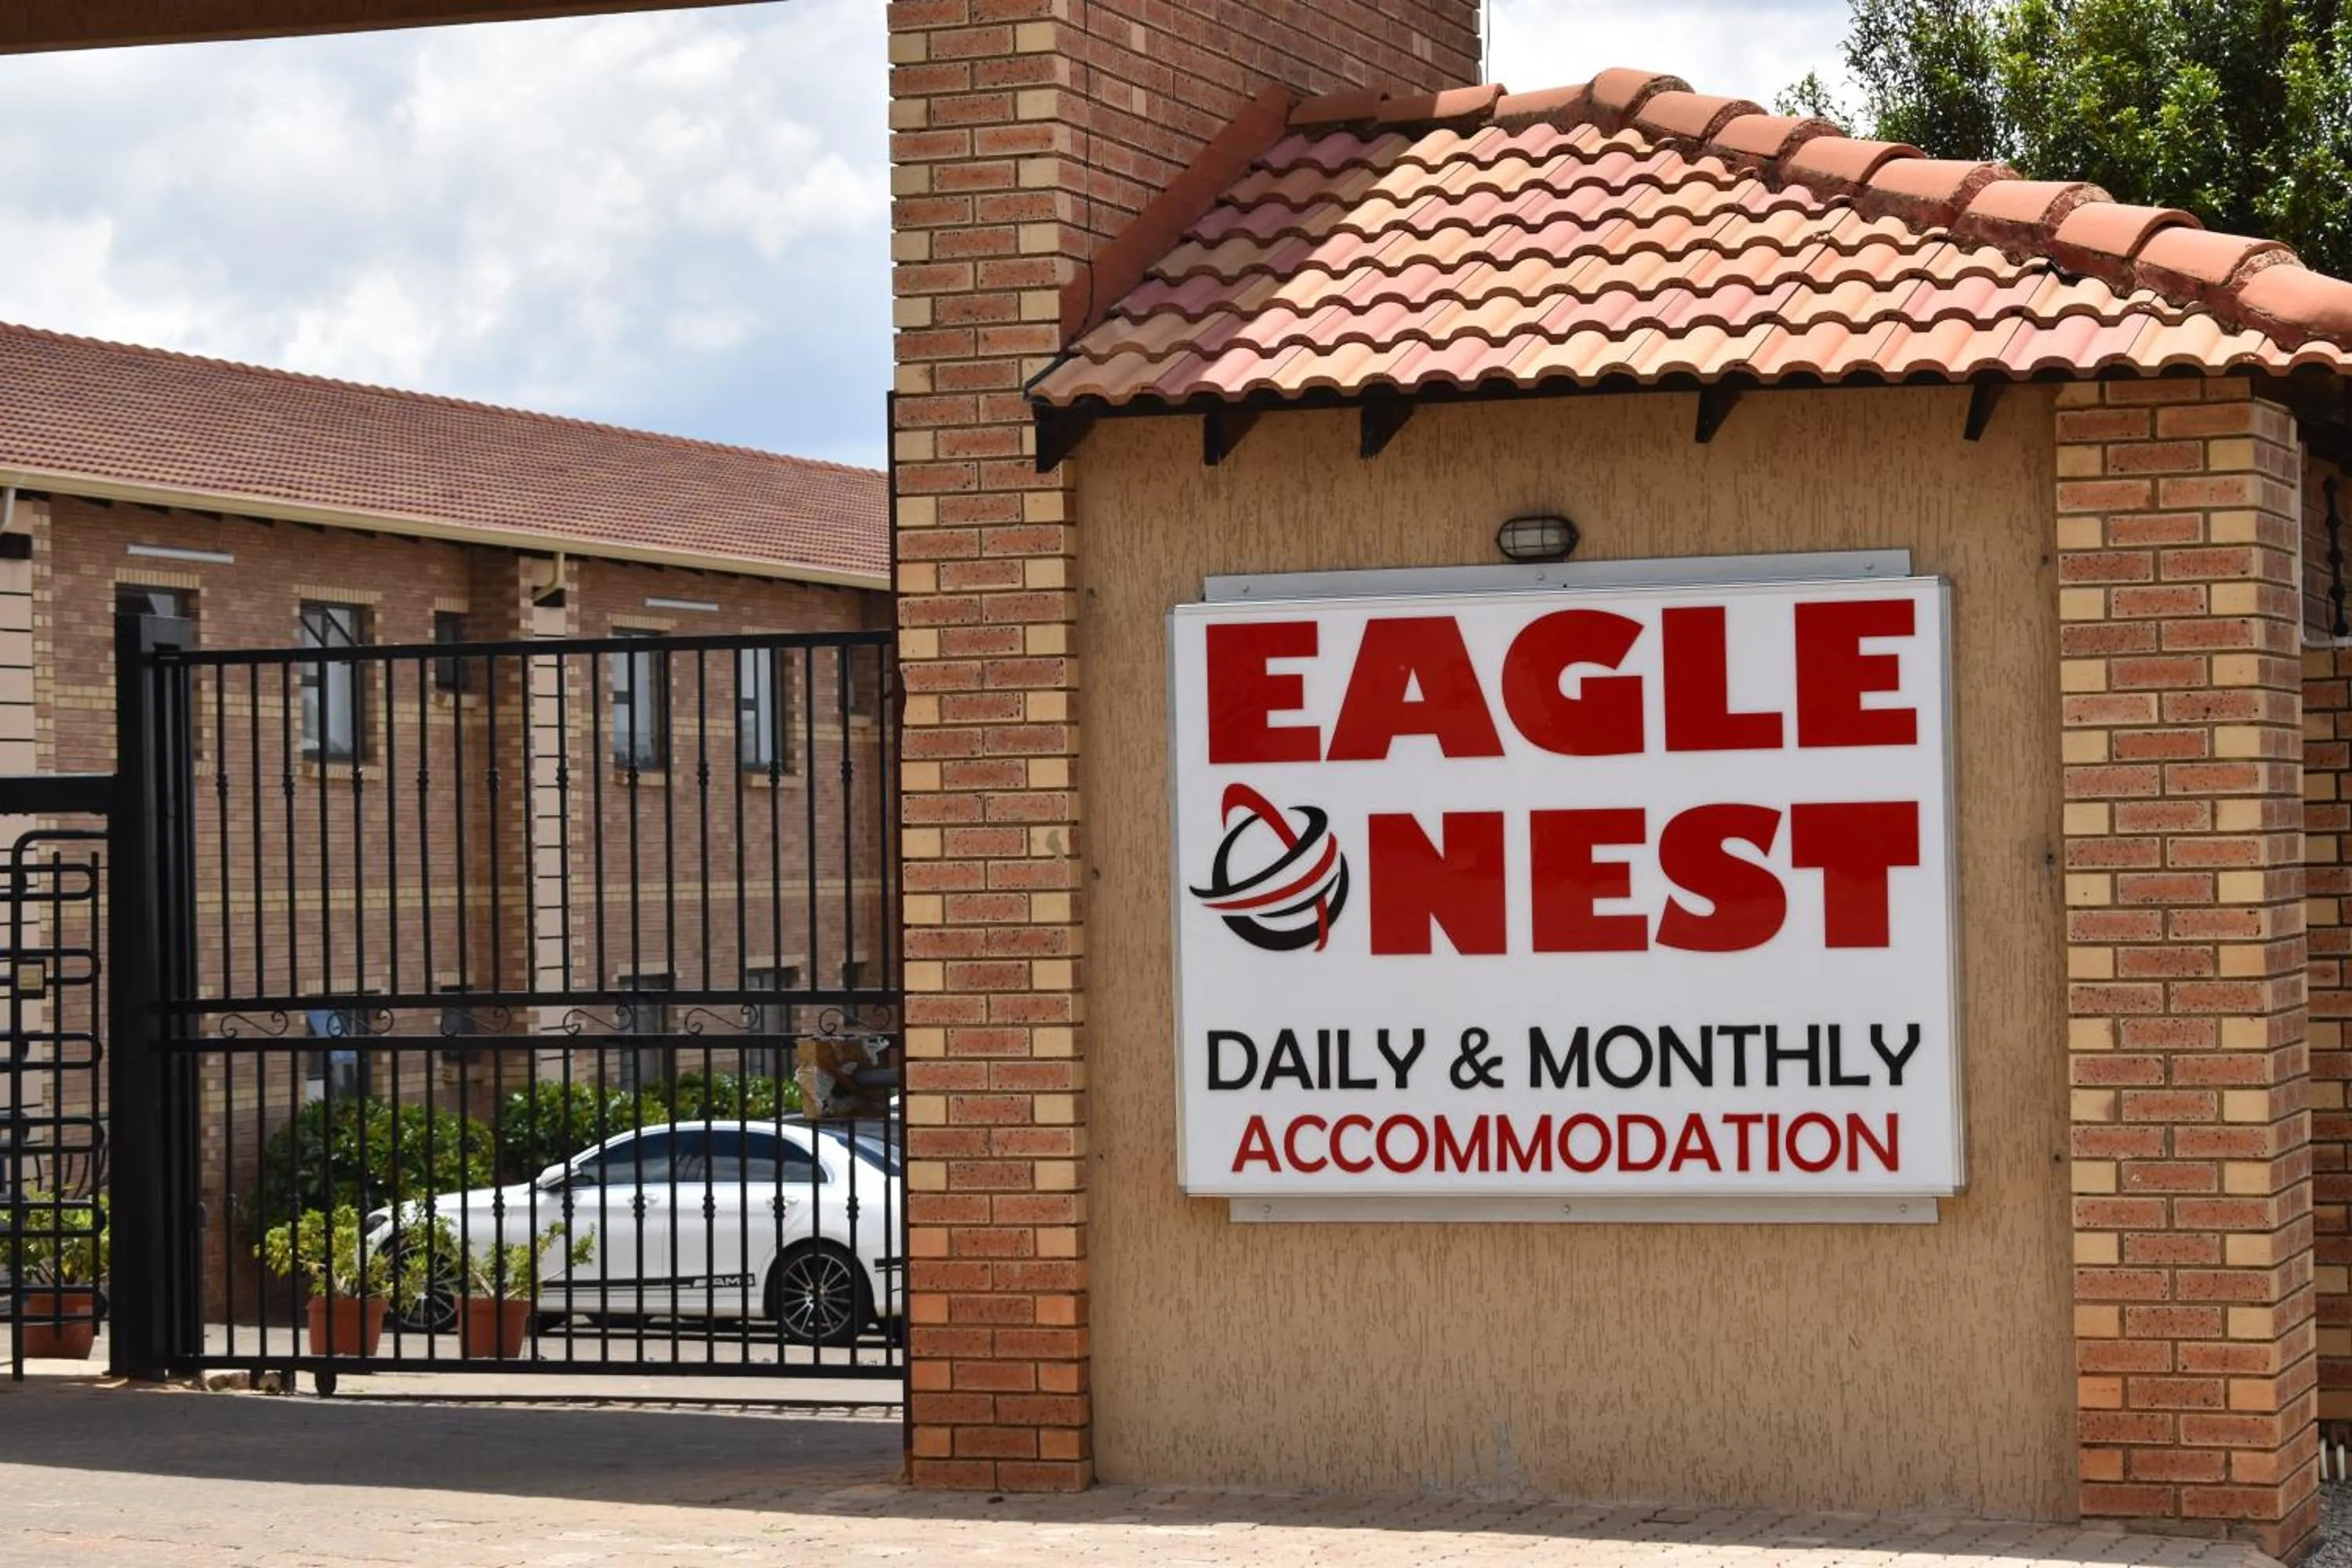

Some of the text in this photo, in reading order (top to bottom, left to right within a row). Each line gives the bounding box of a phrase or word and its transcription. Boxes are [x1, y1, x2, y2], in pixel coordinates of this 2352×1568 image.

[1205, 598, 1918, 765] EAGLE
[1367, 800, 1920, 956] NEST
[1207, 1023, 1921, 1091] DAILY & MONTHLY
[1231, 1111, 1900, 1174] ACCOMMODATION
